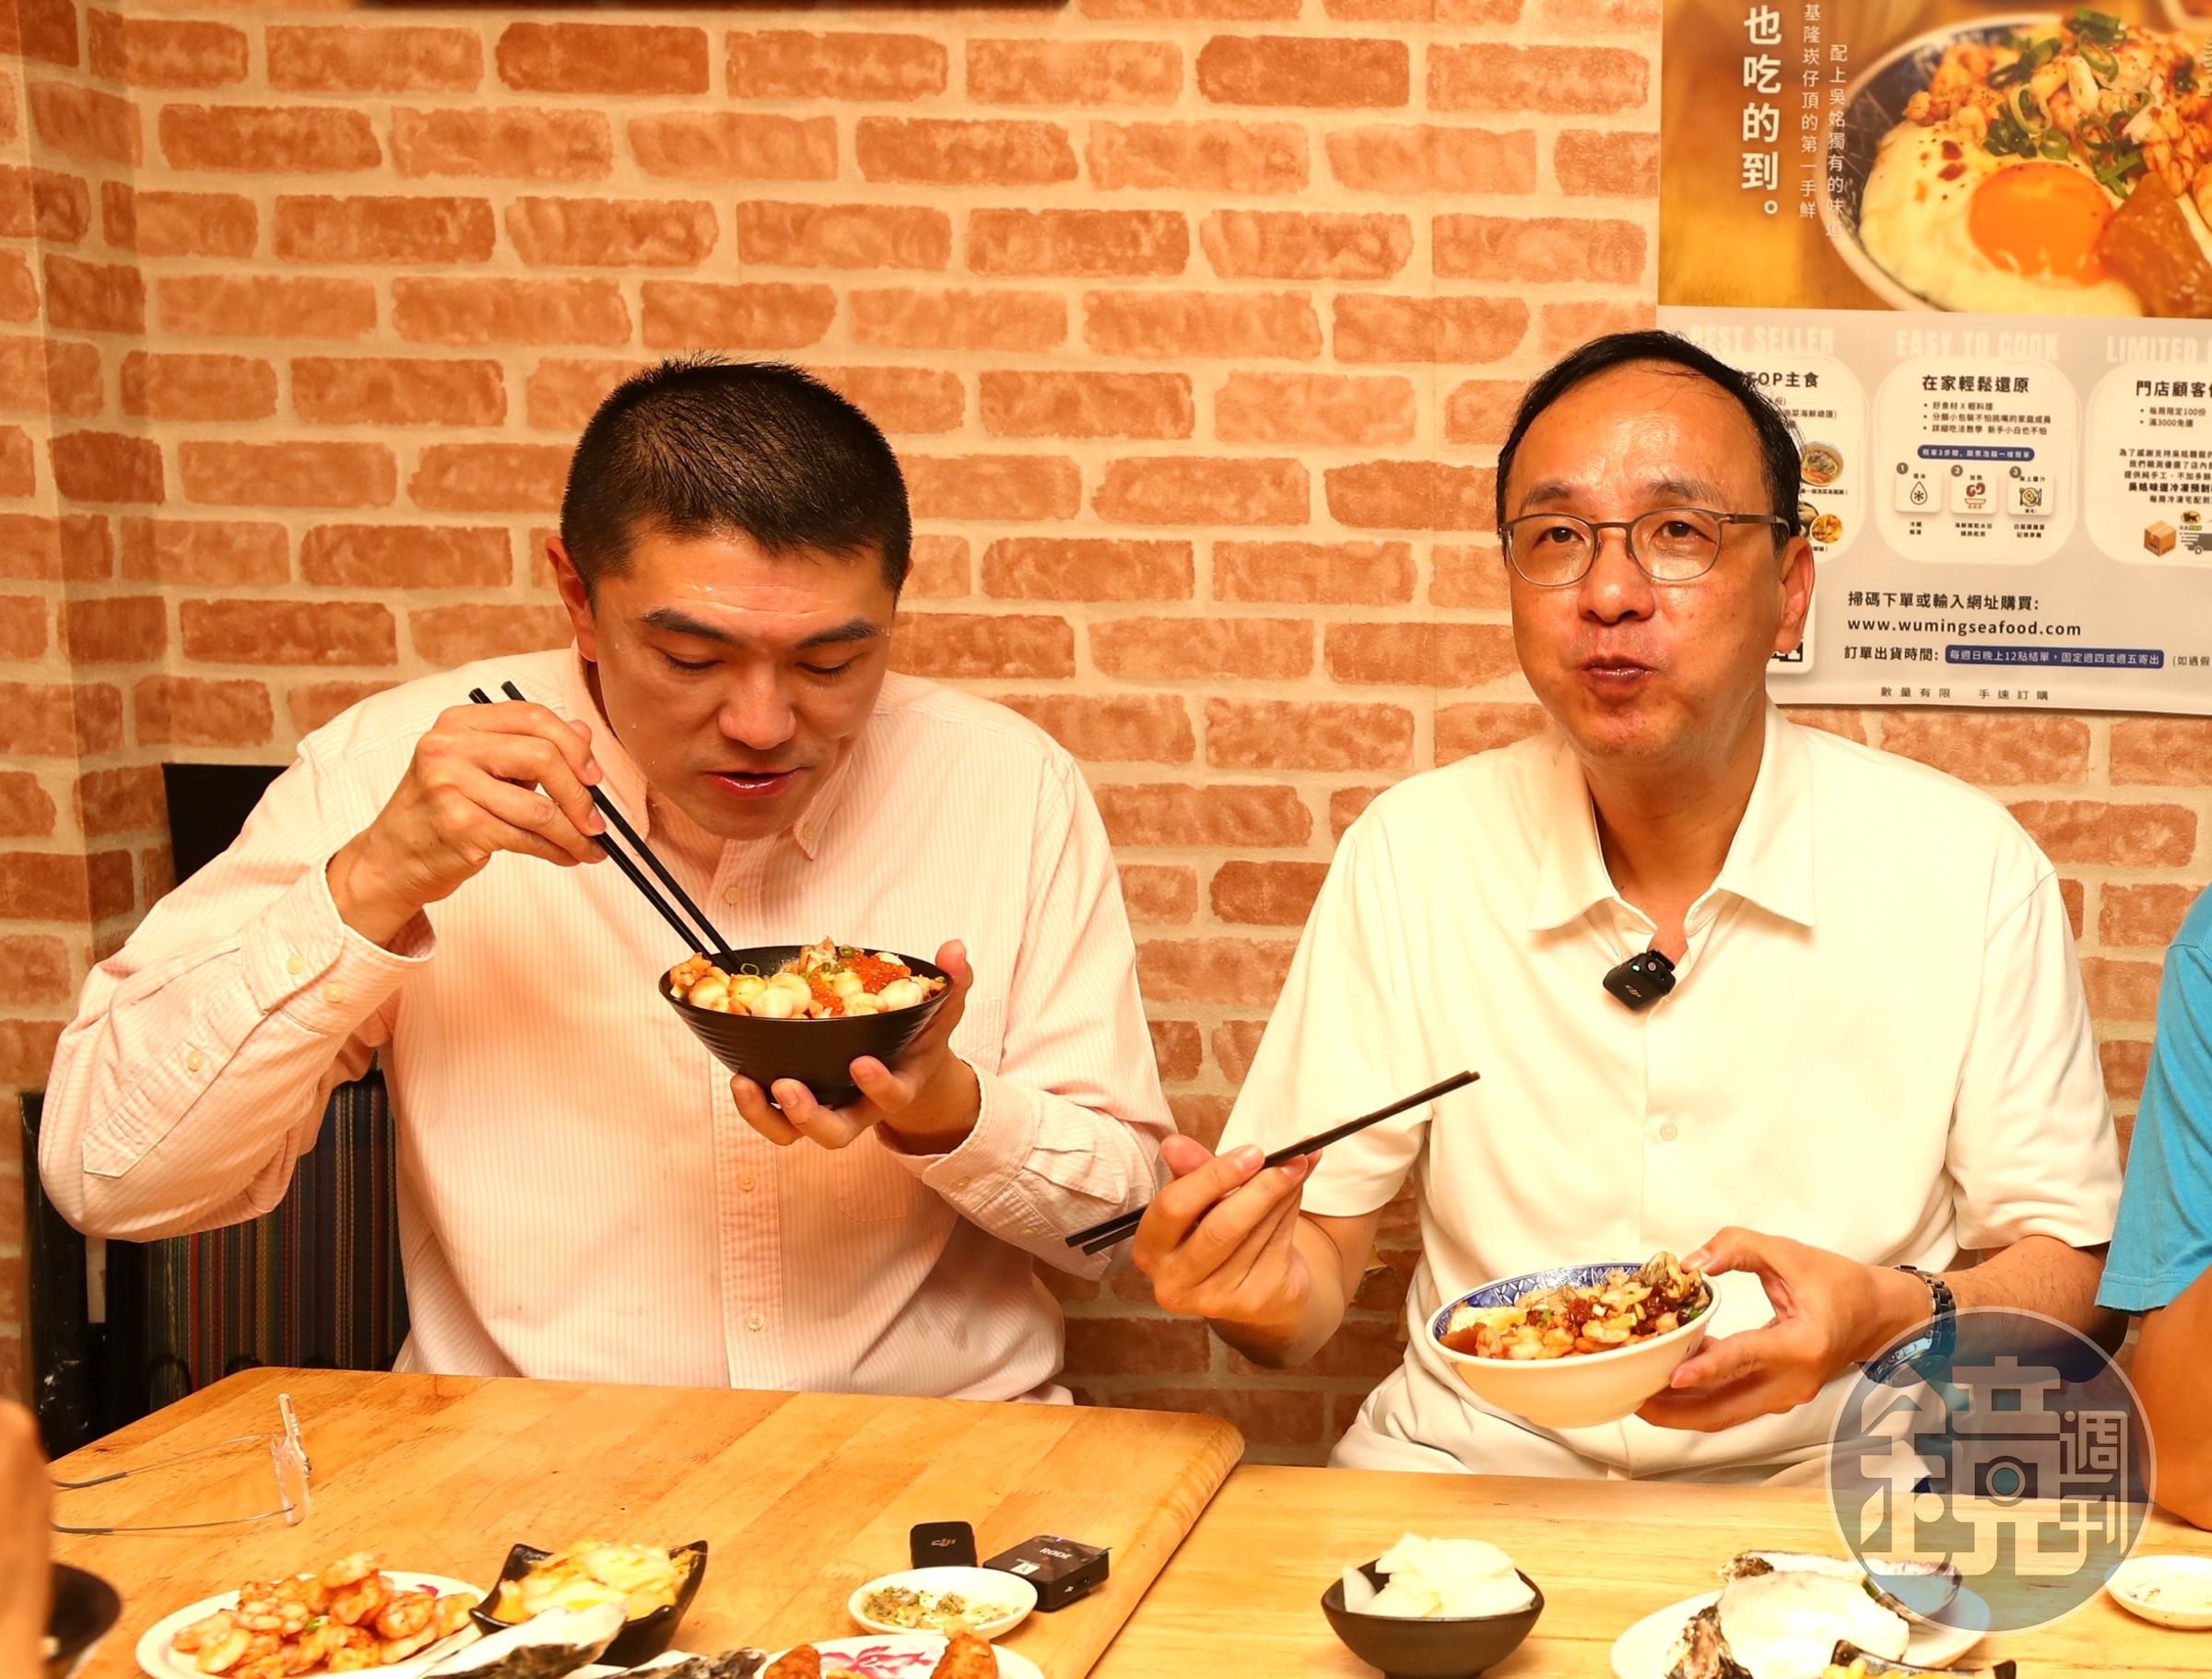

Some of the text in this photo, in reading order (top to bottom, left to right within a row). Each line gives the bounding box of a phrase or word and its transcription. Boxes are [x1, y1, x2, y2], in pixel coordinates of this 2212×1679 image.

[1741, 5, 1783, 215] 也吃的到。
[1799, 4, 1821, 219] 基隆崁仔頂的第一手鮮
[1753, 326, 1835, 354] SELLER
[1896, 329, 2059, 360] EASY TO COOK
[2106, 335, 2198, 362] LIMITED
[1922, 374, 2030, 393] 在家輕鬆還原
[2136, 380, 2212, 398] 門店顧客
[1848, 591, 2039, 611] 掃碼下單或輸入網址購買:
[1848, 618, 2082, 636] www.wumingseafood.com
[1844, 646, 1938, 662] 訂單出貨時間:
[1880, 687, 2049, 700] 數量有限 手速訂購
